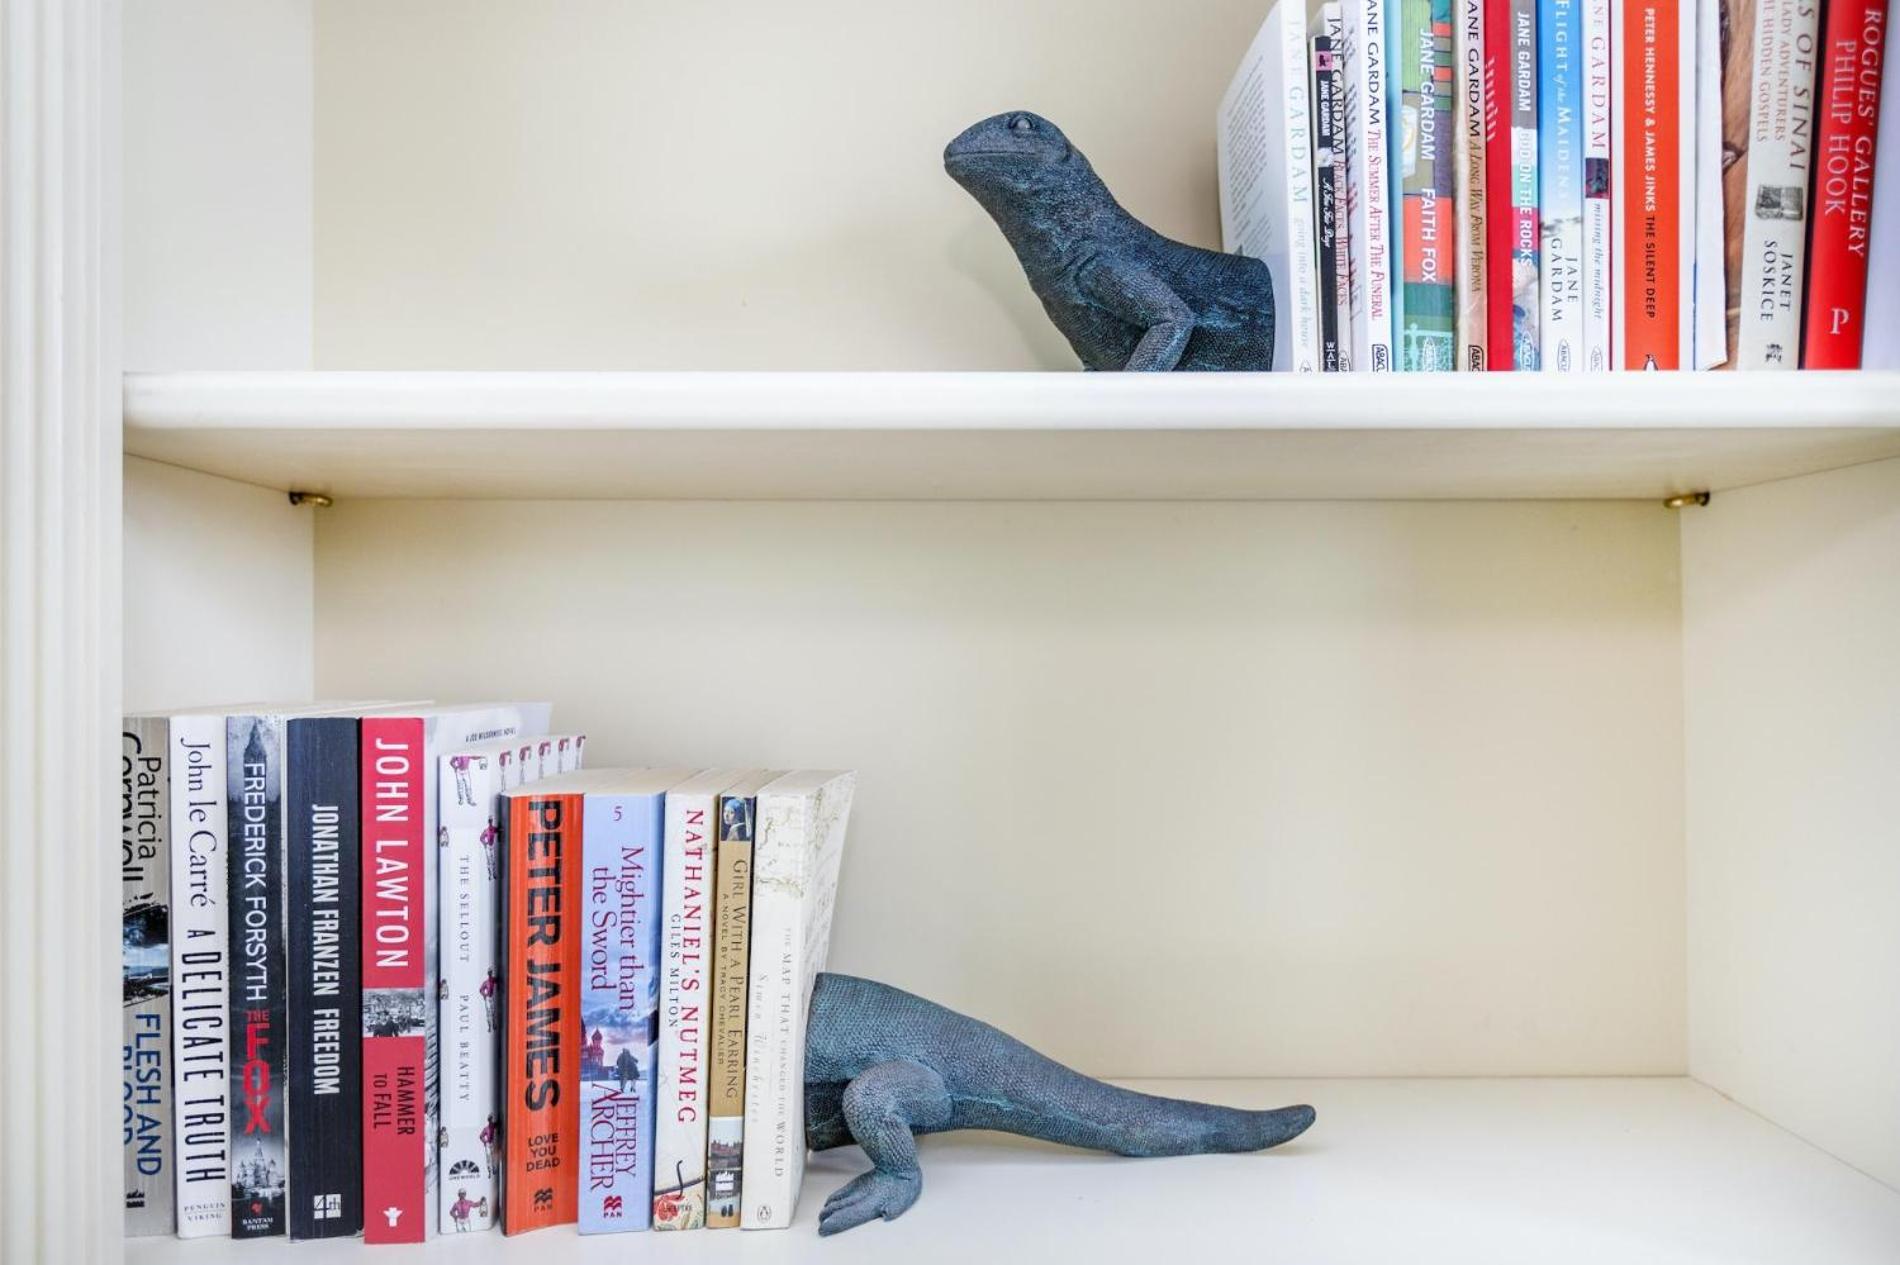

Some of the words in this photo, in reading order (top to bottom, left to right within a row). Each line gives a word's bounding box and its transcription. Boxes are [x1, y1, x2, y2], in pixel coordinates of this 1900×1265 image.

[1327, 18, 1344, 60] JANE
[1518, 12, 1530, 46] JANE
[1555, 0, 1570, 72] FLIGHT
[1644, 8, 1656, 43] PETER
[1780, 1, 1792, 36] LADY
[1420, 29, 1435, 75] JANE
[1760, 18, 1774, 77] HIDDEN
[1795, 33, 1813, 72] OF
[1320, 81, 1330, 100] JANE
[1367, 42, 1381, 125] GARDAM
[1468, 49, 1480, 137] GARDAM
[1518, 51, 1531, 112] GARDAM
[1592, 36, 1606, 149] GARDAM
[1644, 47, 1656, 115] HENNESSY
[1775, 41, 1792, 141] ADVENTURERS
[1831, 40, 1857, 125] PHILIP
[1321, 102, 1331, 136] GARDAM
[1331, 68, 1345, 154] GARDAM
[1420, 81, 1436, 160] GARDAM
[1645, 117, 1656, 127] &
[1756, 82, 1771, 143] GOSPELS
[1790, 85, 1811, 170] SINAI
[1289, 86, 1308, 202] GARDAM
[1368, 130, 1381, 152] THE
[1470, 141, 1481, 150] A
[1645, 131, 1656, 172] JAMES
[1368, 155, 1381, 203] SUMMER
[1470, 154, 1482, 183] LONG
[1520, 164, 1532, 183] ON
[1825, 134, 1851, 216] HOOK
[1421, 188, 1437, 241] FAITH
[1470, 189, 1483, 213] WAY
[1520, 189, 1532, 215] THE
[1645, 175, 1656, 212] JINKS
[1848, 136, 1873, 258] GALLERY
[1369, 206, 1383, 242] AFTER
[1471, 214, 1483, 246] FROM
[1520, 221, 1533, 266] ROCKS
[1645, 216, 1656, 238] THE
[1370, 244, 1384, 268] THE
[1422, 248, 1437, 283] FOX
[1472, 251, 1484, 292] VERONA
[1646, 243, 1656, 284] SILENT
[1300, 287, 1311, 312] dark
[1336, 274, 1349, 306] FACES
[1371, 271, 1385, 320] FUNERAL
[1551, 238, 1563, 322] GARDAM
[1565, 258, 1578, 303] JANE
[1761, 241, 1778, 321] SOSKICE
[1780, 253, 1793, 312] JANET
[1646, 288, 1656, 319] DEEP
[1830, 307, 1850, 335] P
[180, 737, 213, 792] John
[375, 737, 410, 822] JOHN
[137, 757, 162, 860] Patricia
[189, 801, 217, 822] le
[244, 762, 267, 889] FREDERICK
[614, 806, 623, 822] 5
[189, 830, 218, 908] Carré
[312, 804, 340, 903] JONATHAN
[460, 854, 470, 886] THE
[527, 801, 562, 949] PETER
[592, 867, 617, 904] the
[615, 847, 645, 949] Mightier
[681, 810, 705, 992] NATHANIEL'S
[732, 860, 748, 899] GIRL
[375, 840, 410, 967] LAWTON
[721, 905, 729, 940] NOVEL
[187, 929, 216, 939] A
[245, 898, 268, 1001] FORSYTH
[460, 893, 470, 962] SELLOUT
[670, 913, 681, 959] GILES
[731, 905, 747, 952] WITH
[782, 927, 792, 946] THE
[312, 910, 340, 996] FRANZEN
[591, 910, 618, 992] Sword
[721, 946, 728, 959] BY
[730, 959, 741, 968] A
[782, 953, 792, 985] MAP
[619, 955, 645, 1011] than
[669, 968, 680, 1028] MILTON
[719, 966, 727, 1000] TRACY
[729, 976, 744, 1020] PEARL
[182, 951, 224, 1082] DELICATE
[245, 1010, 270, 1022] THE
[459, 994, 470, 1033] PAUL
[525, 959, 561, 1112] JAMES
[718, 1005, 726, 1066] CHEVALIER
[780, 994, 791, 1033] THAT
[135, 1014, 161, 1105] FLESH
[313, 1008, 341, 1095] FREEDOM
[459, 1041, 470, 1102] BEATTY
[678, 1006, 699, 1124] NUTMEG
[726, 1029, 743, 1099] EARRING
[779, 1039, 789, 1092] CHANGED
[242, 1022, 272, 1136] FOX
[373, 1074, 389, 1089] TO
[397, 1066, 416, 1136] HAMMER
[373, 1093, 392, 1130] FALL
[778, 1096, 788, 1114] THE
[136, 1114, 162, 1176] AND
[184, 1095, 226, 1183] TRUTH
[527, 1133, 560, 1148] LOVE
[531, 1145, 557, 1158] YOU
[590, 1083, 624, 1192] ARCHER
[615, 1094, 640, 1178] JEFFREY
[775, 1120, 786, 1178] WORLD
[526, 1157, 561, 1172] DEAD
[184, 1202, 226, 1212] PENGUIN
[187, 1213, 223, 1222] VIKING
[534, 1204, 553, 1213] PAN
